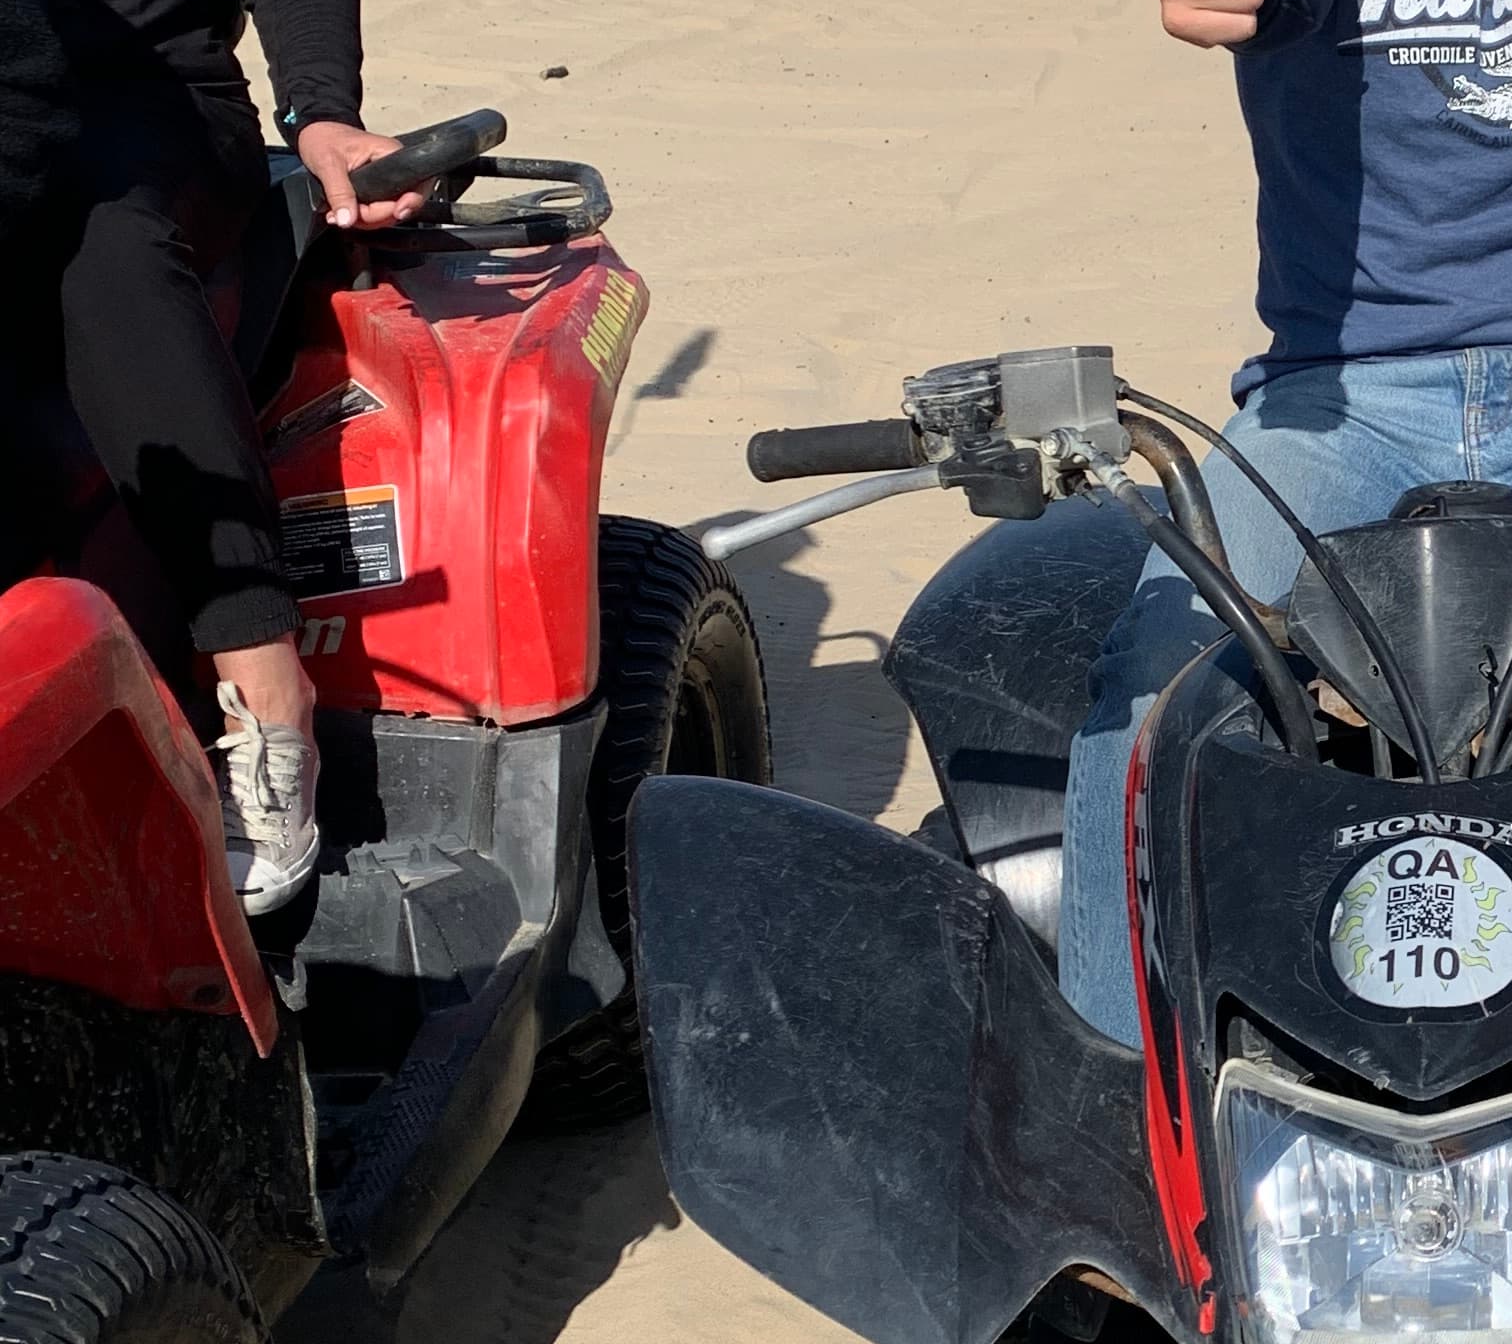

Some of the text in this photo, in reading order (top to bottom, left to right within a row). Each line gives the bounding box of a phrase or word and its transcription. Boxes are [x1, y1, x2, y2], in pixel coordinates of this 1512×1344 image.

[1387, 46, 1476, 65] CROCODILE
[1387, 848, 1460, 881] QA
[1378, 944, 1461, 983] 110
